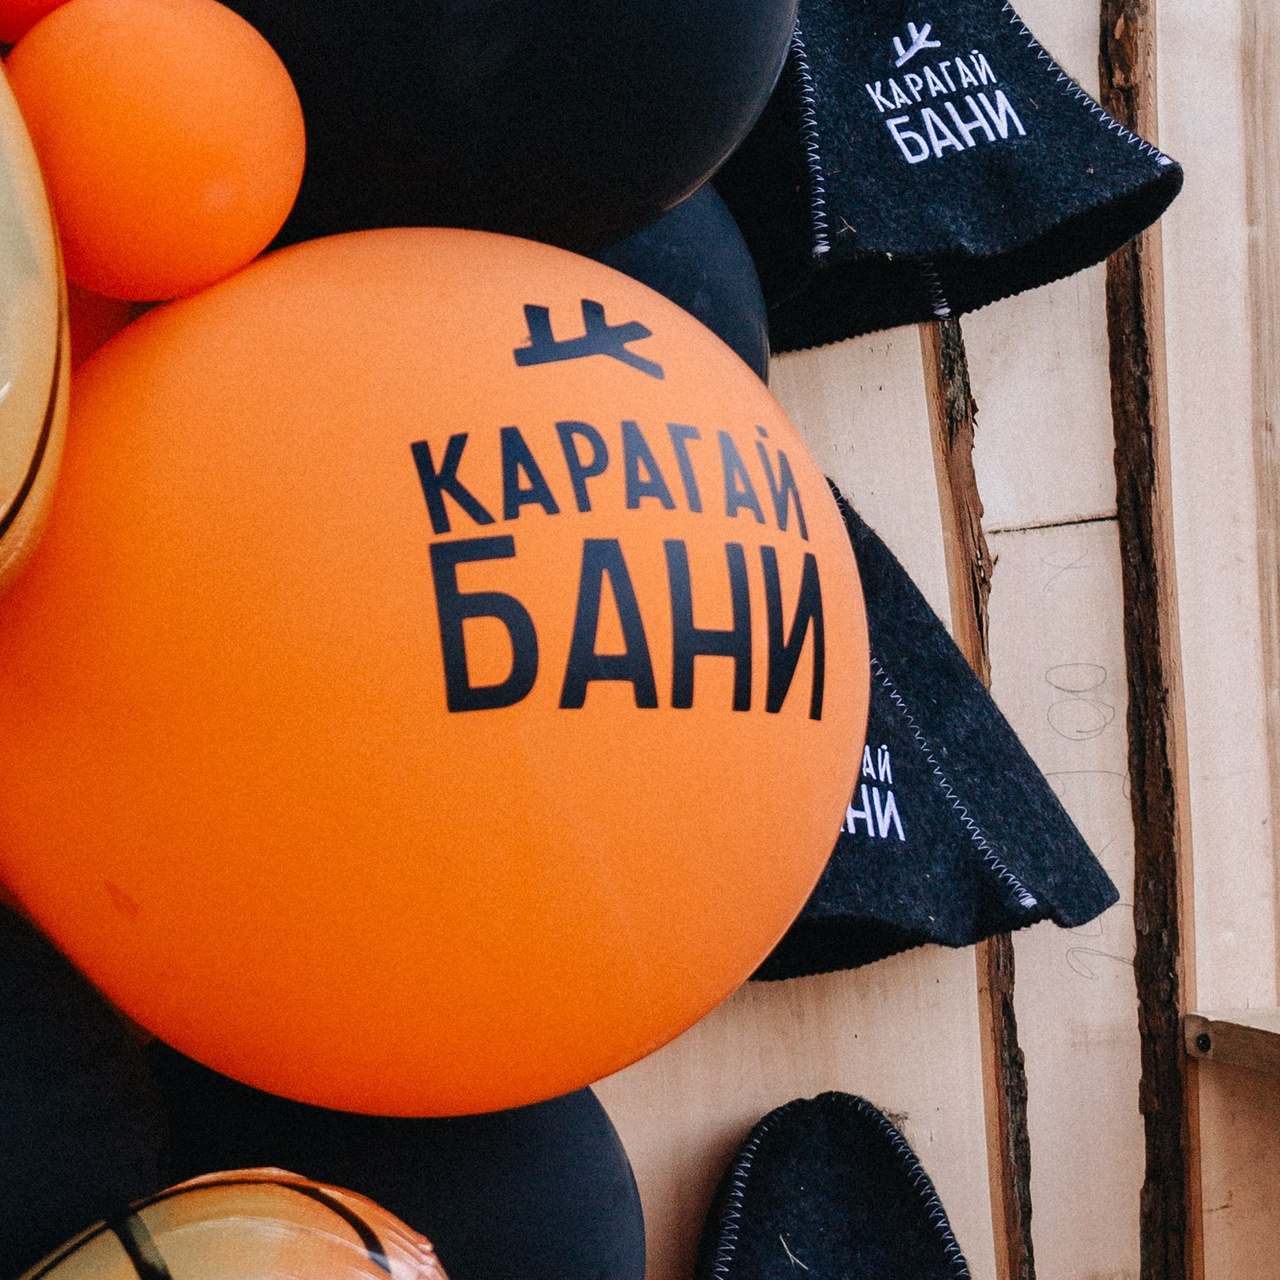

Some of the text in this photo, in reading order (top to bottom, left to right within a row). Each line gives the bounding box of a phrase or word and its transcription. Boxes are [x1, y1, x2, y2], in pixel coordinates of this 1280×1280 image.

[865, 49, 997, 112] КАРАГАЙ
[885, 90, 1026, 164] БАНИ
[410, 420, 809, 541] КАРАГАЙ
[428, 535, 825, 721] БАНИ
[840, 783, 906, 841] НИ
